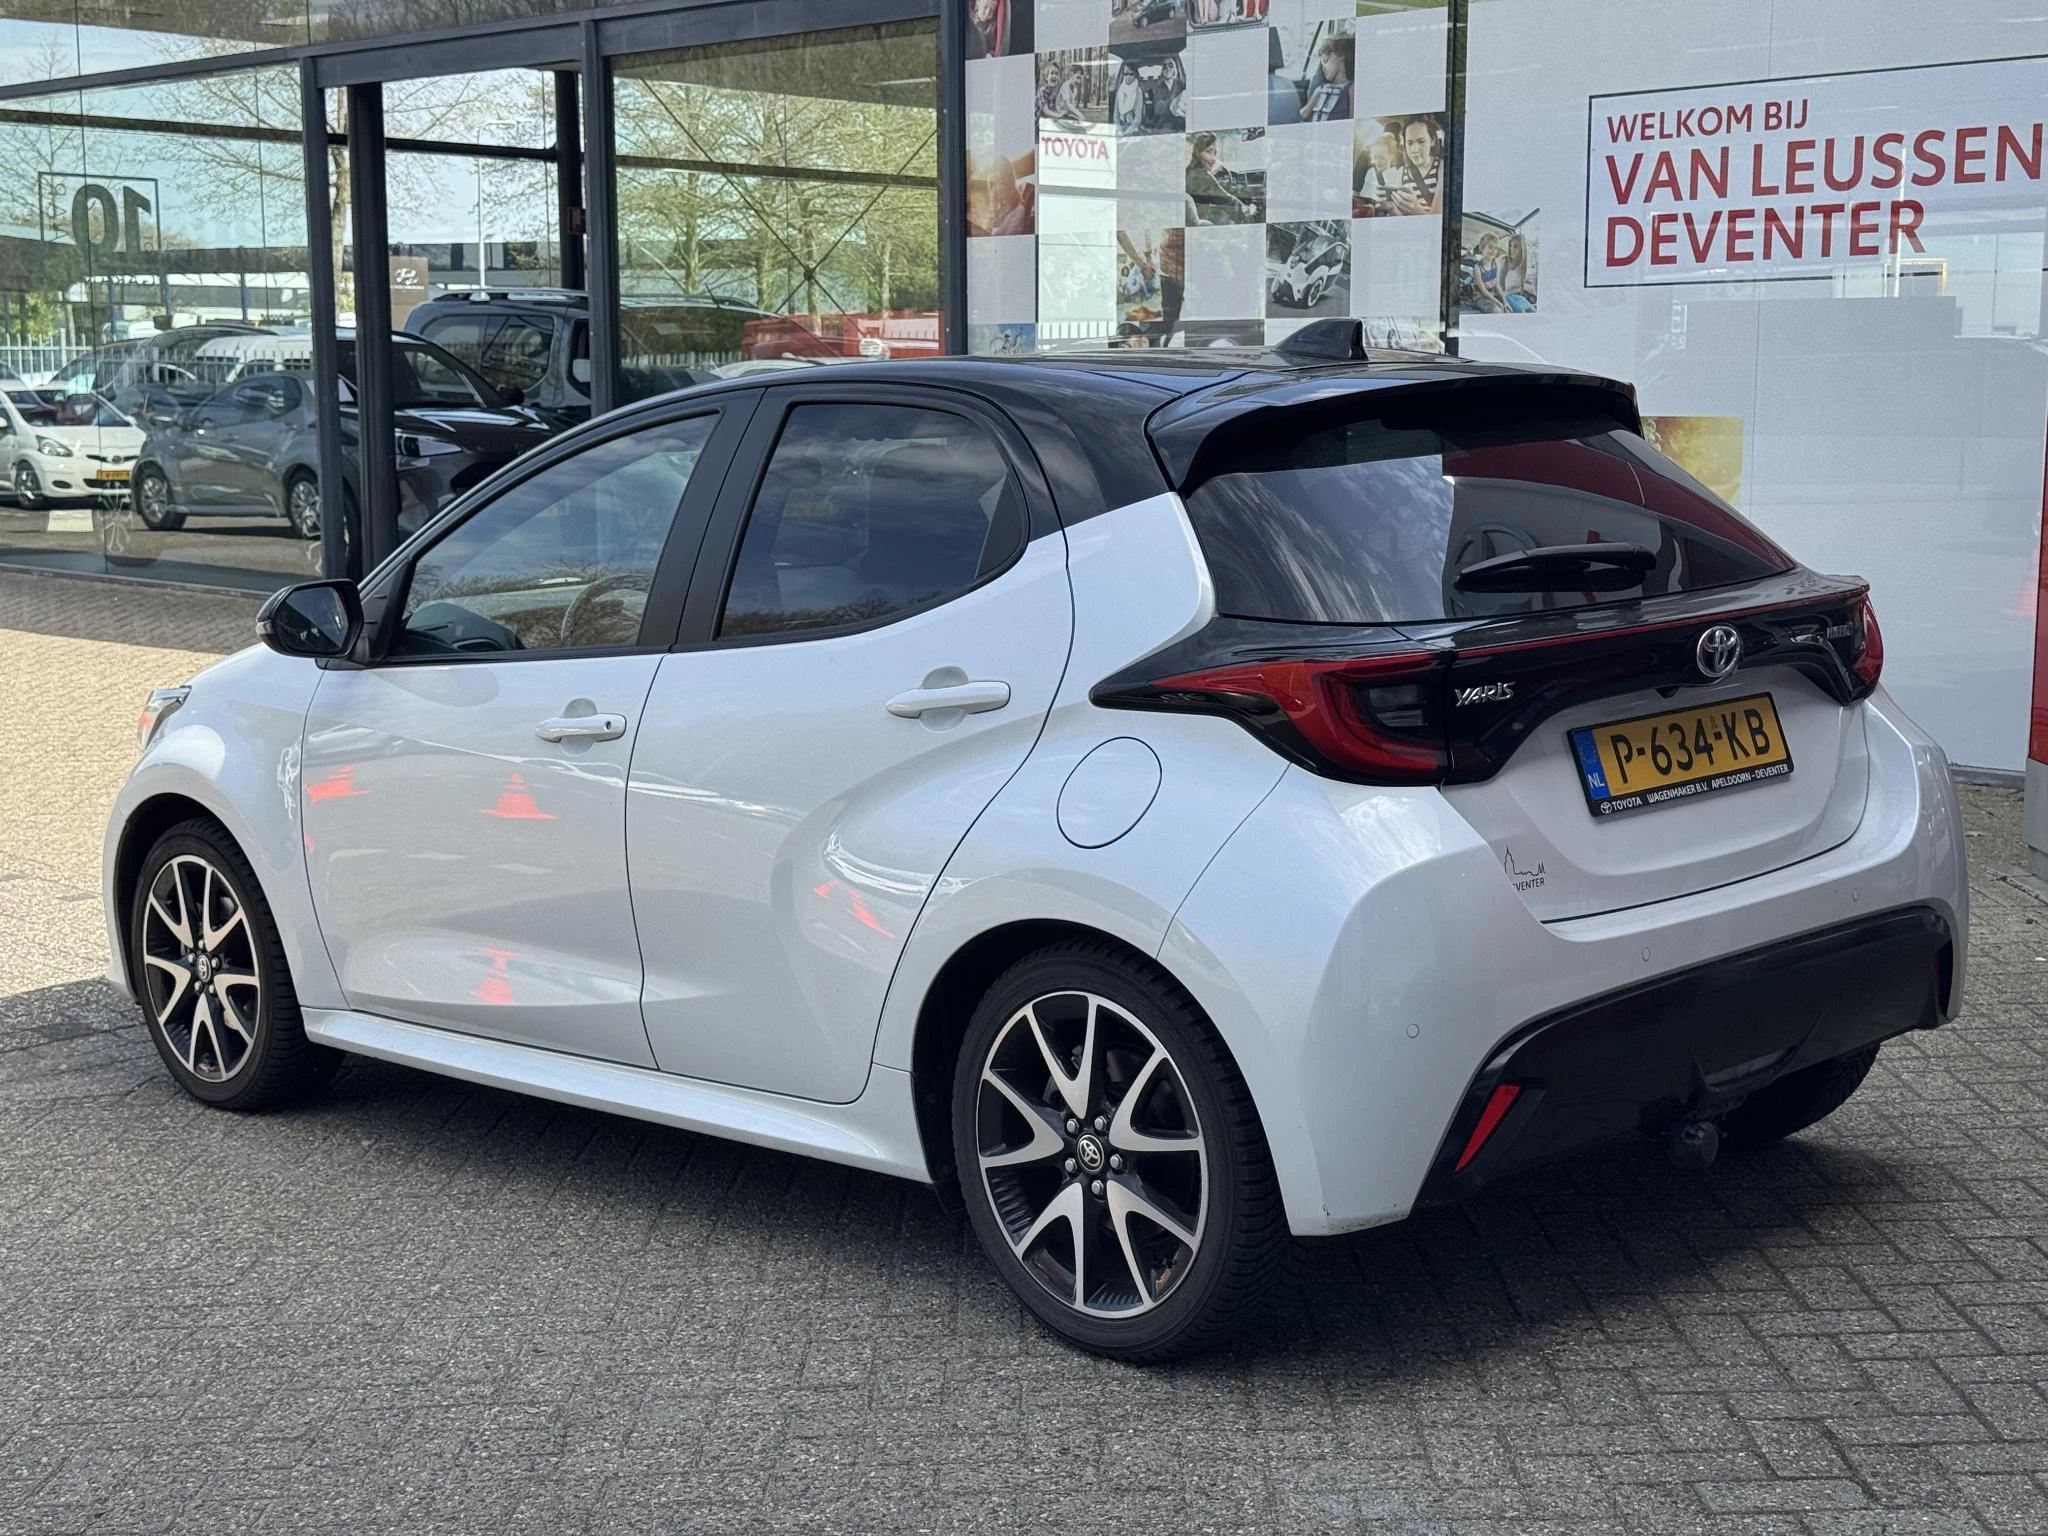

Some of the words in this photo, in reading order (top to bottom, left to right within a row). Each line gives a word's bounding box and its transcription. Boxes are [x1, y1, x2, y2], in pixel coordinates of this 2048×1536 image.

[1606, 103, 1753, 144] WELKOM
[1763, 98, 1809, 132] BIJ
[1041, 136, 1109, 160] TOYOTA
[1605, 146, 1730, 206] VAN
[1751, 122, 2044, 197] LEUSSEN
[1605, 199, 1927, 268] DEVENTER
[1610, 708, 1771, 785] P-634-KB
[1587, 772, 1606, 789] NL
[1611, 796, 1643, 811] TOYOTA
[1646, 784, 1697, 803] WAGENMAKER
[1512, 877, 1545, 892] VENTER
